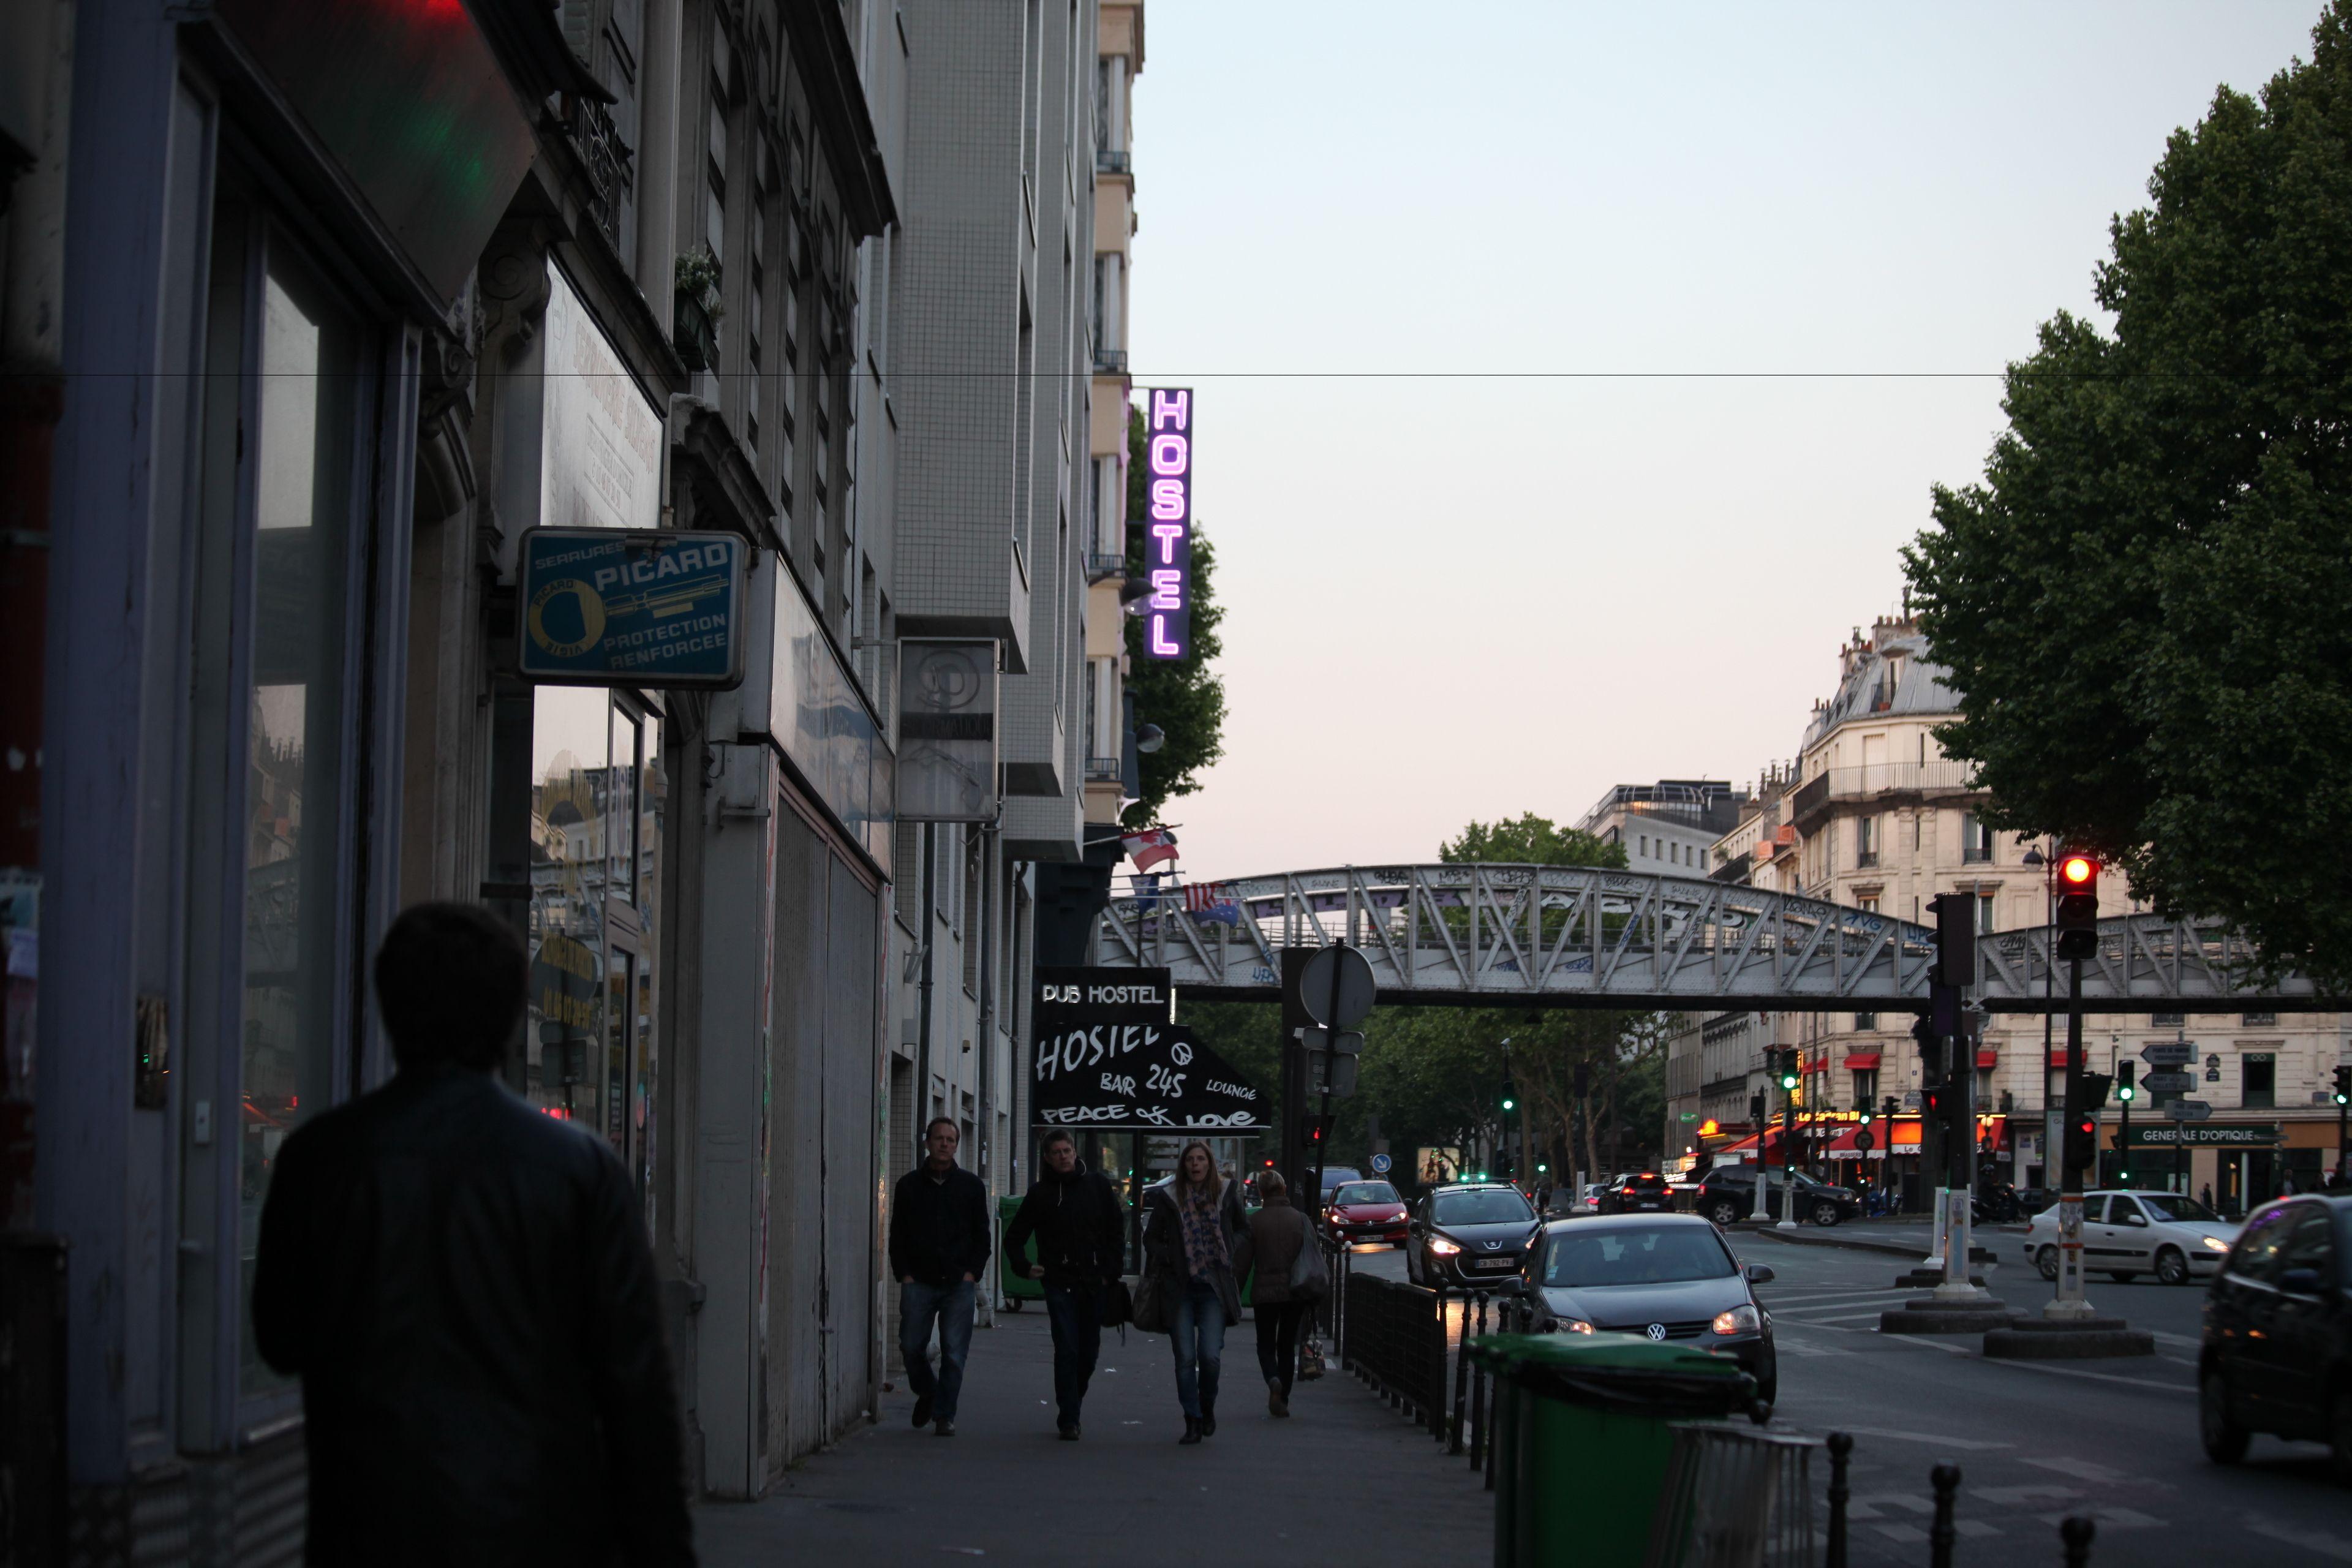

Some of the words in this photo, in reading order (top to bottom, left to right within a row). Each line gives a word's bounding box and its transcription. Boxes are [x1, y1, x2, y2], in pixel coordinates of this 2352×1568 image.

[1152, 390, 1188, 655] HOSTEL
[535, 541, 625, 570] SERRURES
[594, 543, 728, 592] PICARD
[534, 579, 575, 608] PICARD
[603, 613, 726, 651] PROTECTION
[610, 633, 726, 669] RENFORCEE
[1043, 984, 1080, 1003] DUB
[1089, 986, 1164, 1004] HOSTEL
[1101, 1073, 1136, 1098] BAR
[1145, 1064, 1186, 1098] 245
[1205, 1079, 1257, 1101] LOUNGE
[1041, 1104, 1130, 1123] PEACE
[1798, 1112, 1811, 1122] Le
[2200, 1130, 2253, 1141] D'OPTIQUE
